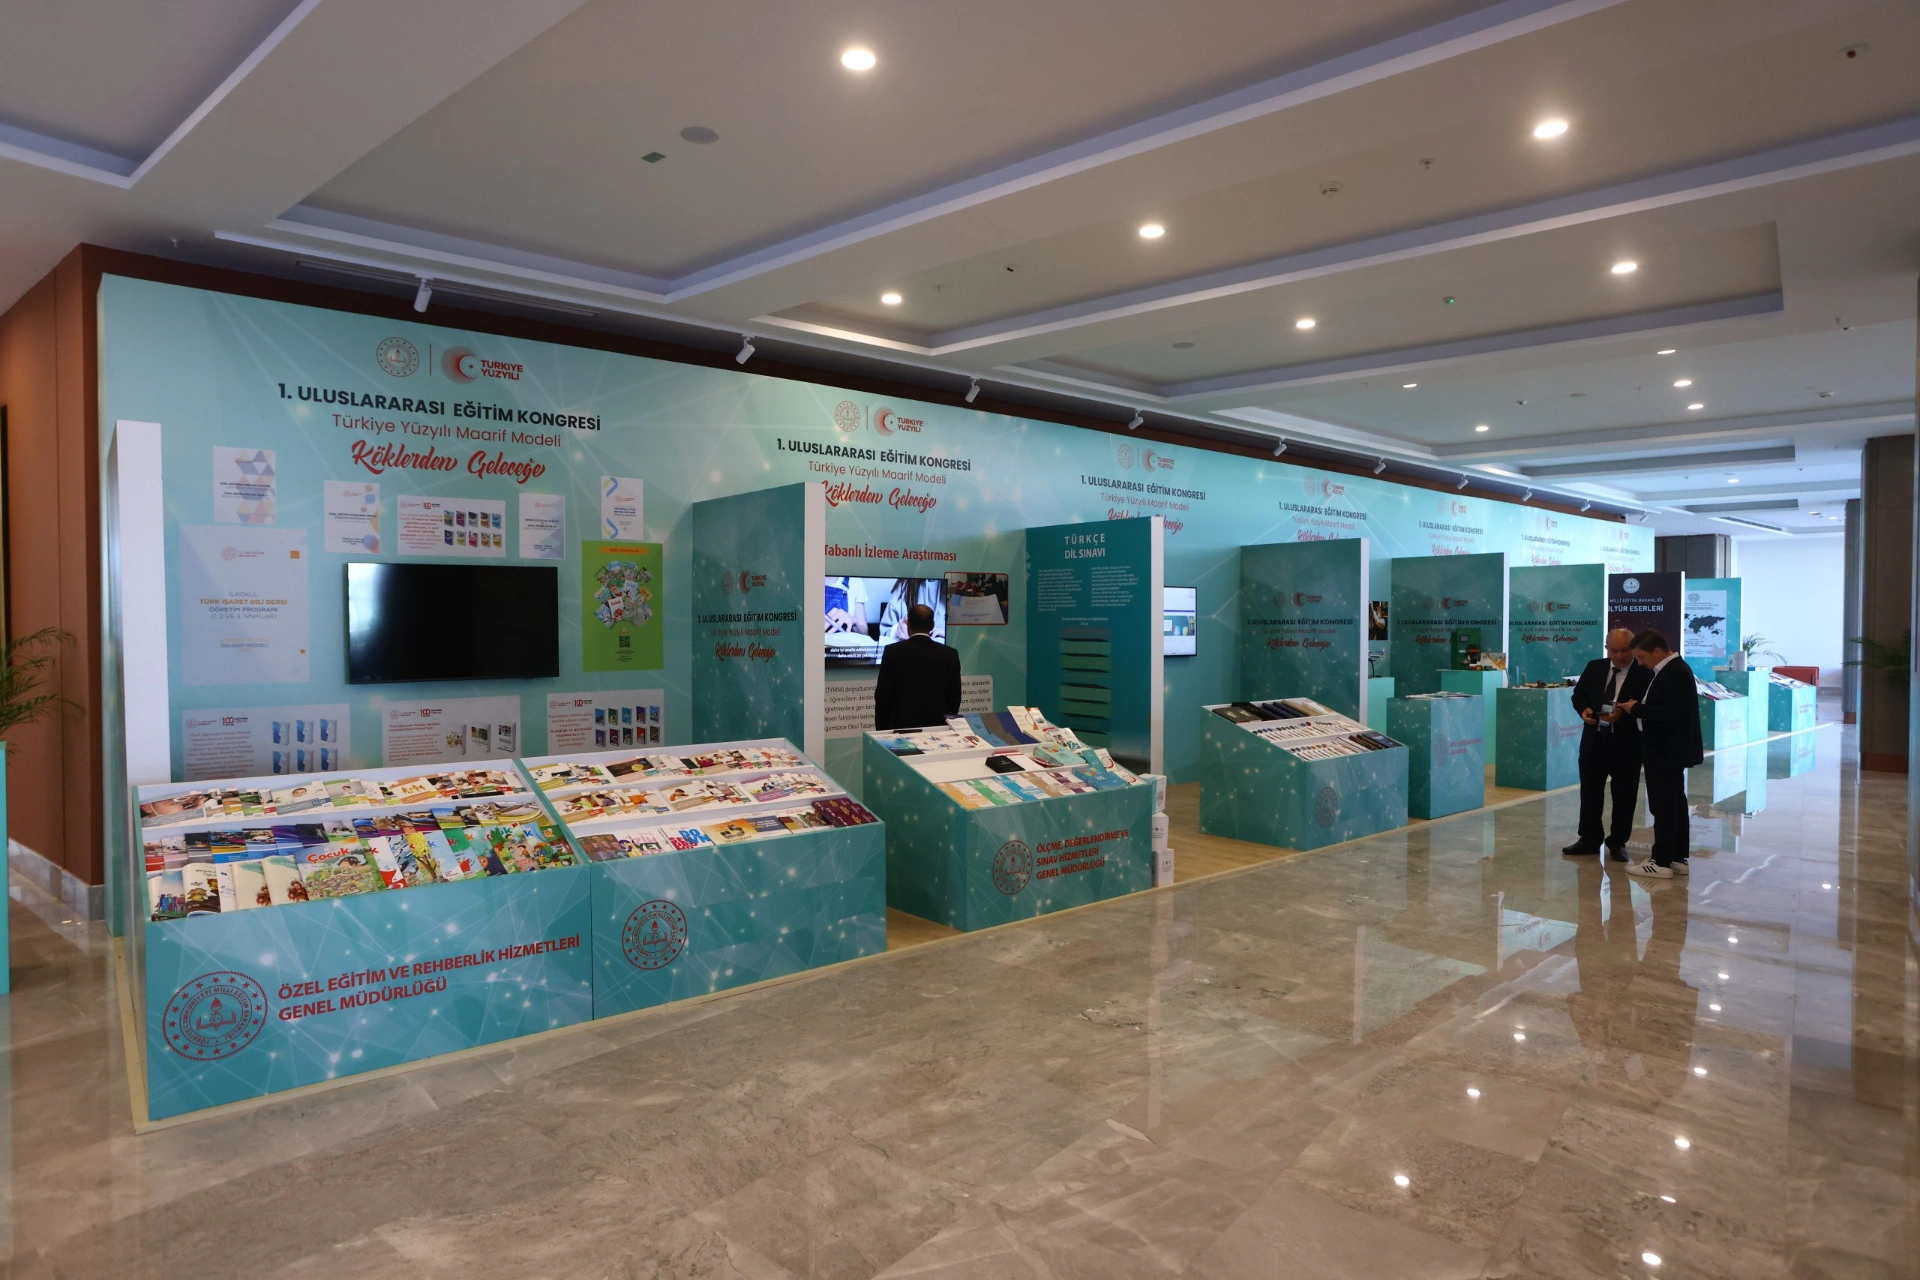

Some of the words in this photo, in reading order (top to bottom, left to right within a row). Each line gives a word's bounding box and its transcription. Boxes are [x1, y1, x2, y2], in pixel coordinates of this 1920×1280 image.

[278, 383, 292, 399] 1.
[298, 386, 445, 415] ULUSLARARASI
[453, 400, 513, 422] EĞİTİM
[517, 410, 600, 431] KONGRESİ
[332, 413, 396, 435] Türkiye
[400, 421, 450, 440] Yüzyılı
[456, 426, 507, 442] Maarif
[511, 431, 561, 447] Modeli
[351, 439, 458, 475] Köklerden
[467, 450, 546, 485] Geleceğe
[777, 438, 785, 450] 1.
[788, 440, 876, 461] ULUSLARARASI
[880, 449, 917, 465] EĞİTİM
[919, 455, 971, 471] KONGRESİ
[808, 460, 846, 476] Türkiye
[849, 465, 879, 480] Yüzyılı
[882, 469, 913, 481] Maarif
[916, 473, 946, 485] Modeli
[822, 480, 883, 507] Köklerden
[889, 487, 937, 514] Geleceğe
[1081, 475, 1086, 485] 1.
[1088, 476, 1144, 492] ULUSLARARASI
[1147, 483, 1171, 496] EĞİTİM
[1172, 487, 1206, 500] KONGRESİ
[1101, 492, 1125, 505] Türkiye
[1127, 495, 1146, 507] Yüzyılı
[1148, 500, 1168, 509] Maarif
[1170, 502, 1189, 511] Modeli
[1284, 503, 1322, 515] ULUSLARARASI
[1325, 507, 1341, 517] EĞİTİM
[1342, 511, 1366, 520] KONGRESİ
[1065, 533, 1106, 545] TÜRKÇE
[865, 543, 899, 559] İzleme
[902, 548, 957, 562] Araştırması
[1065, 548, 1078, 559] DİL
[1079, 547, 1106, 558] SINAVI
[703, 613, 741, 623] ULUSLARARASI
[744, 611, 764, 622] EĞİTİM
[765, 610, 797, 621] KONGRESİ
[1065, 831, 1120, 848] DEĞERLENDİRME
[1120, 829, 1129, 837] VE
[307, 847, 350, 864] Çocuk
[1037, 856, 1058, 867] SINAV
[1060, 847, 1099, 862] HİZMETLERİ
[1037, 869, 1059, 880] GENEL
[1061, 857, 1105, 875] MÜDÜRLÜĞÜ
[277, 981, 325, 1000] ÖZEL
[327, 969, 387, 992] EĞİTİM
[390, 965, 410, 980] VE
[413, 949, 495, 976] REHBERLİK
[498, 933, 580, 960] HİZMETLERİ
[278, 1001, 336, 1022] GENEL
[339, 976, 447, 1010] MÜDÜRLÜĞÜ
